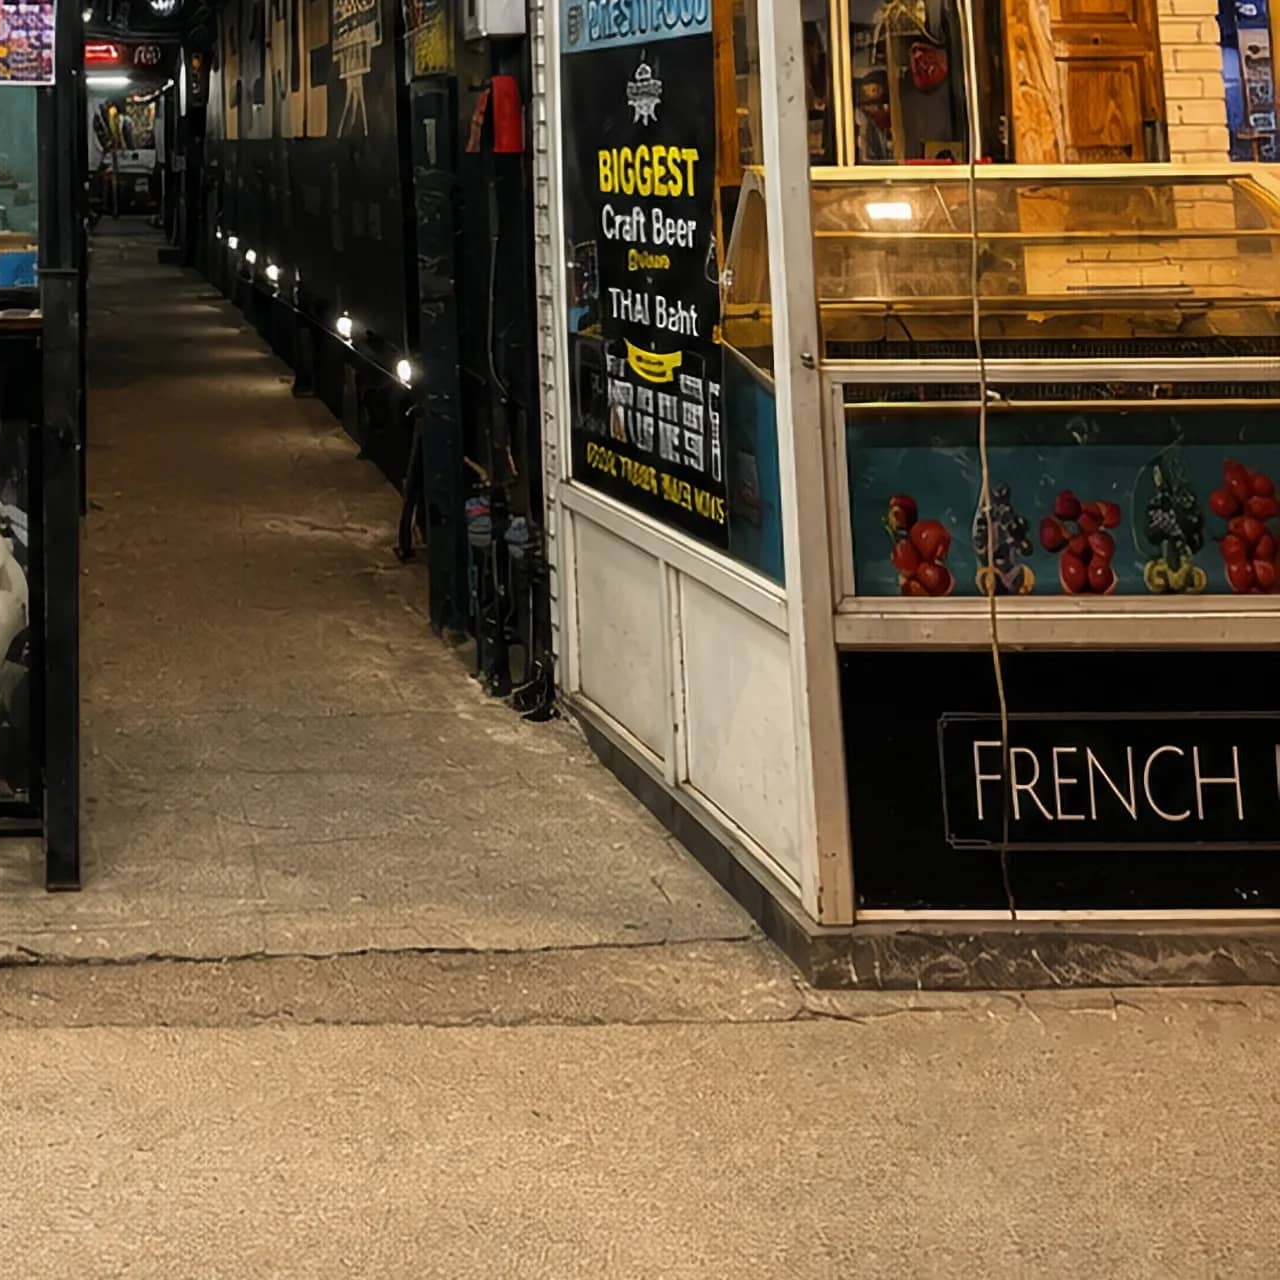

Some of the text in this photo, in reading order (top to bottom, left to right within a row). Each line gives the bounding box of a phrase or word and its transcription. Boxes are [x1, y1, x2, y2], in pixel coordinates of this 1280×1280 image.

[598, 144, 700, 197] BIGGEST
[601, 203, 697, 248] Craft Beer
[608, 287, 700, 337] THAI Baht
[973, 741, 1244, 821] FRENCH
